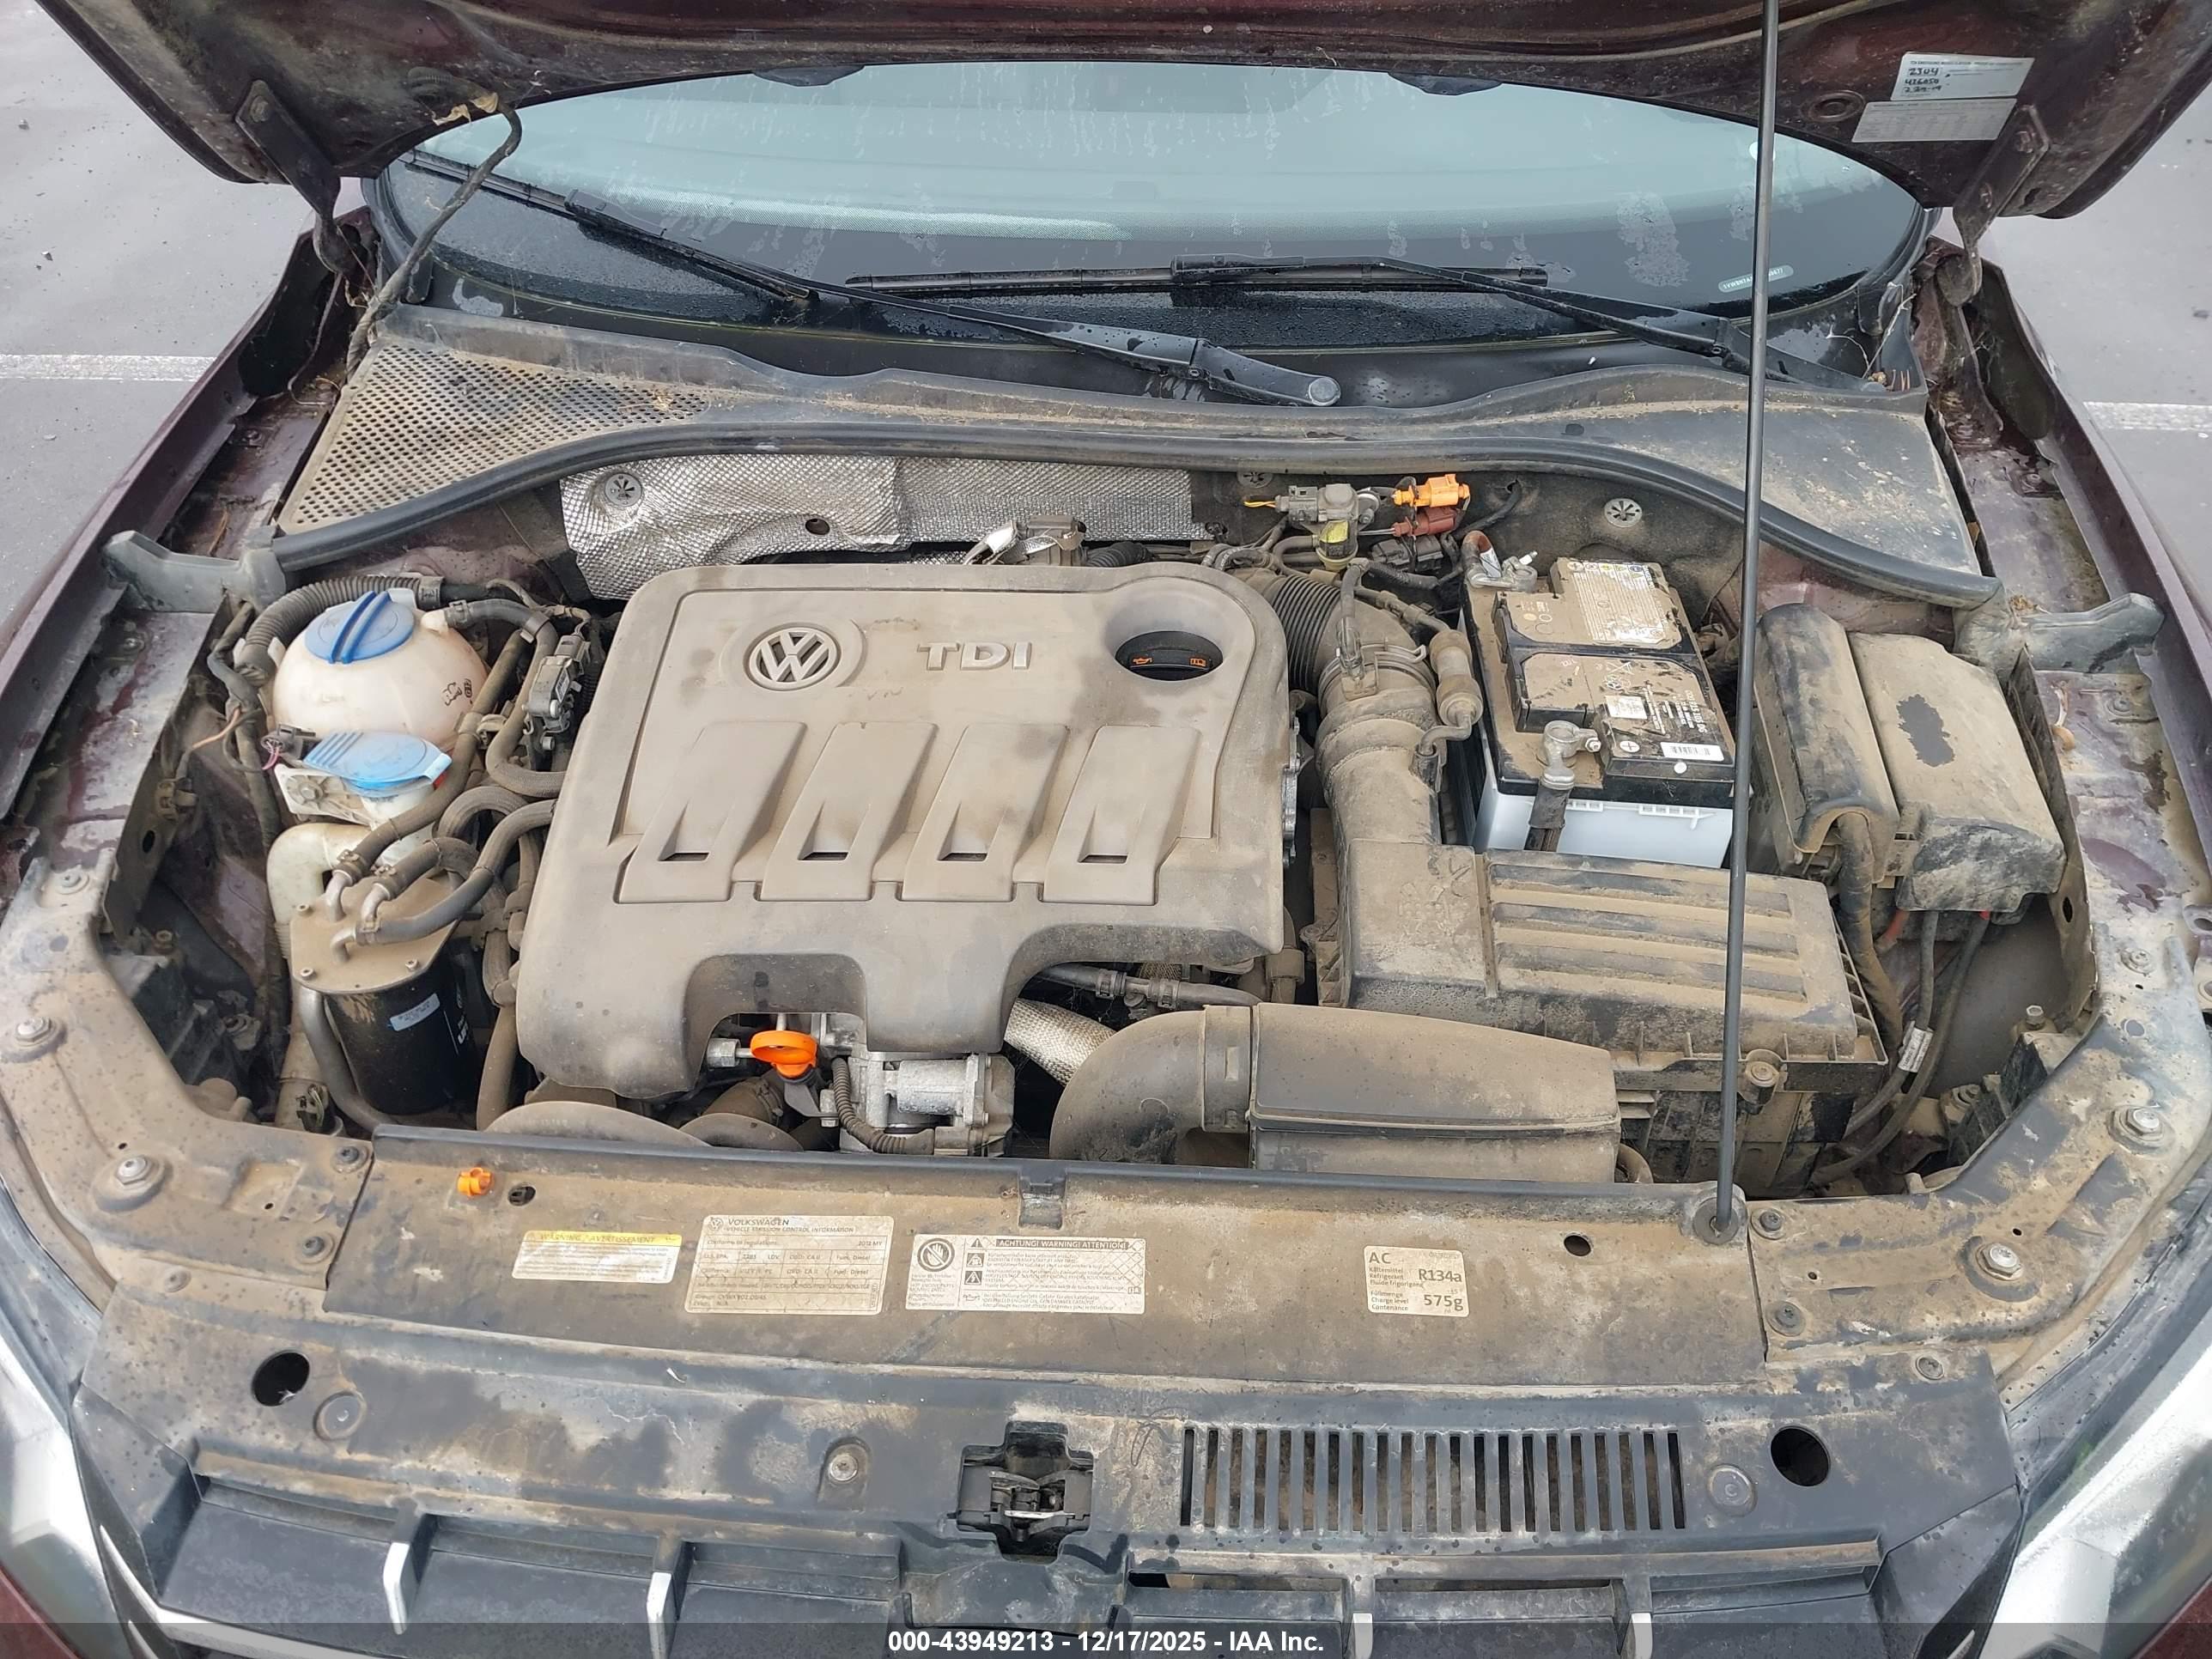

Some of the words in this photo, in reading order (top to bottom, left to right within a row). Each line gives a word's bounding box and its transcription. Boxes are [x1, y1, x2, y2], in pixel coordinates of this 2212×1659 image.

[916, 641, 1032, 671] TDI
[728, 1217, 789, 1226] VOLKSWAGEN
[1000, 1239, 1039, 1248] ACHTUNG!
[1039, 1240, 1080, 1249] WARNING!
[1082, 1242, 1127, 1250] ATTENTION!
[1369, 1251, 1392, 1265] AC
[1418, 1267, 1463, 1283] R134a
[1370, 1290, 1404, 1298] Füllmenge
